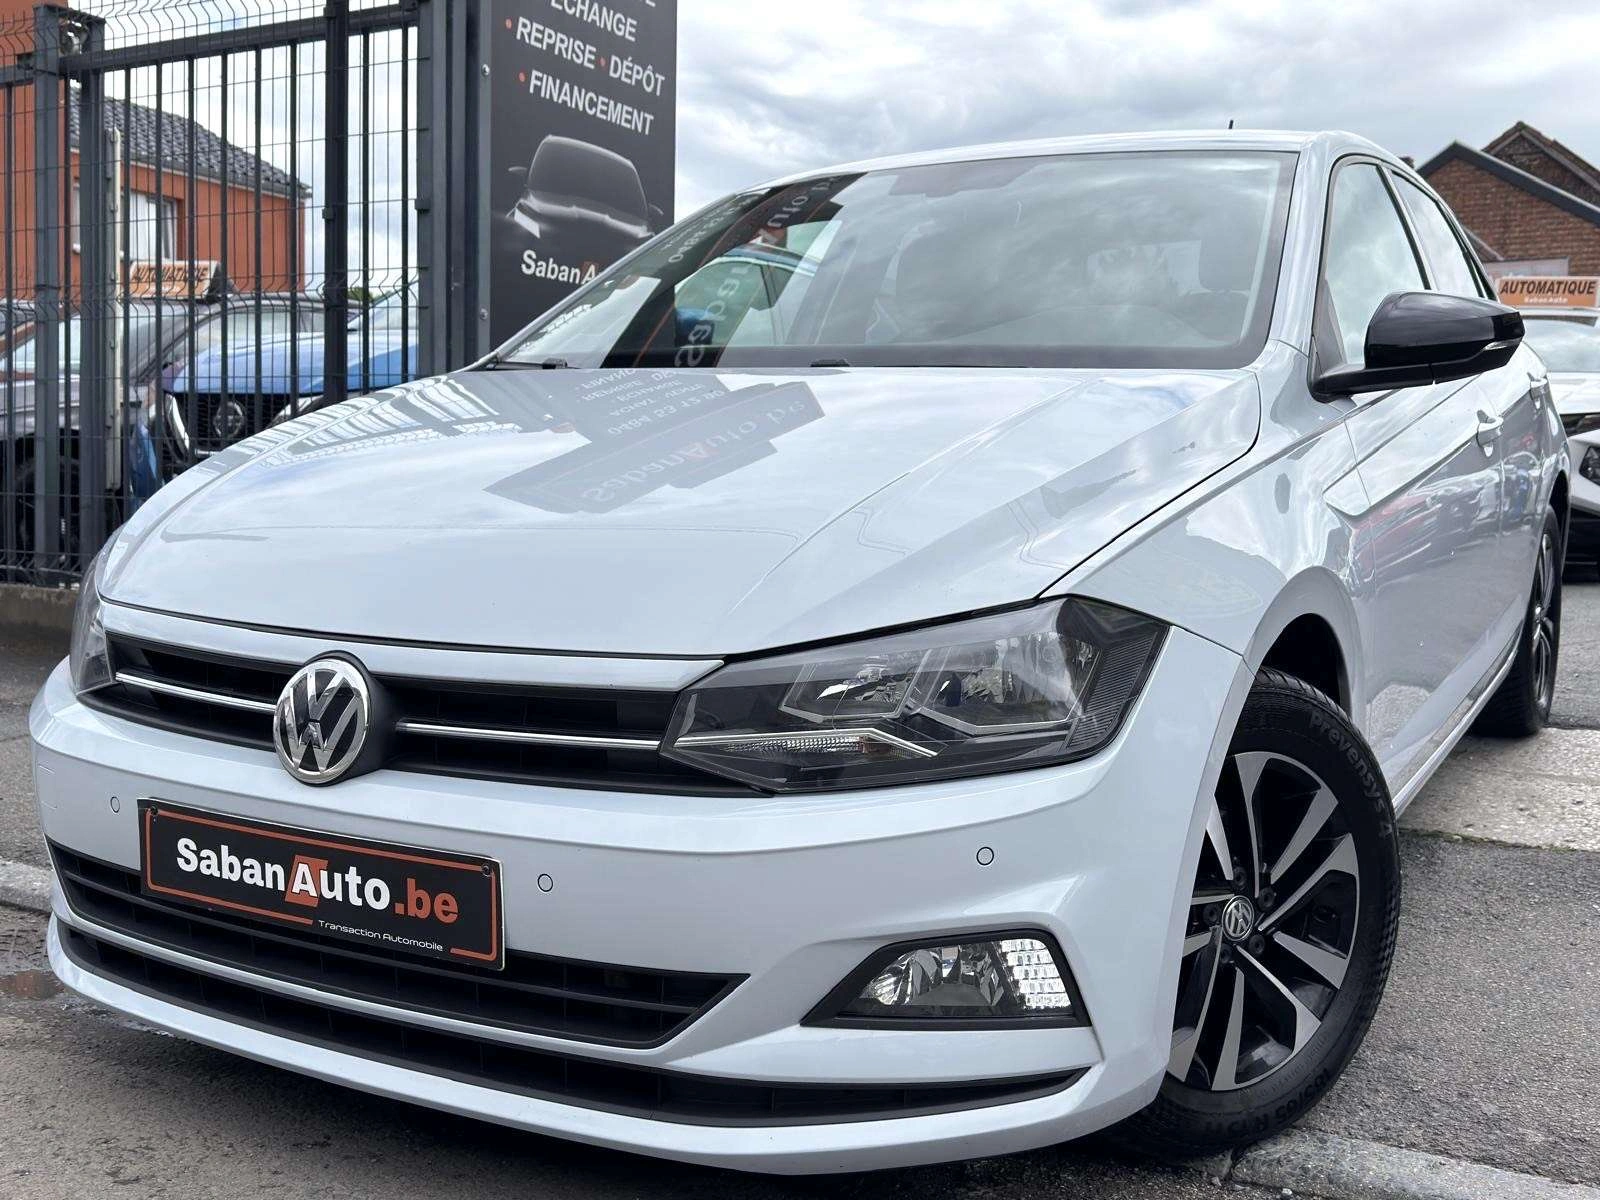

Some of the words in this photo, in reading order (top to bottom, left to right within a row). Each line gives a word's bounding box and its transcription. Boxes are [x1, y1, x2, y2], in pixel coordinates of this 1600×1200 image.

[516, 17, 597, 69] REPRISE
[609, 55, 665, 96] DÉPÔT
[529, 70, 654, 135] FINANCEMENT
[521, 249, 601, 286] SabanA
[1500, 280, 1597, 295] AUTOMATIQUE
[176, 838, 459, 924] SabanAuto.be
[318, 919, 381, 939] Transaction
[382, 933, 444, 952] Automobile
